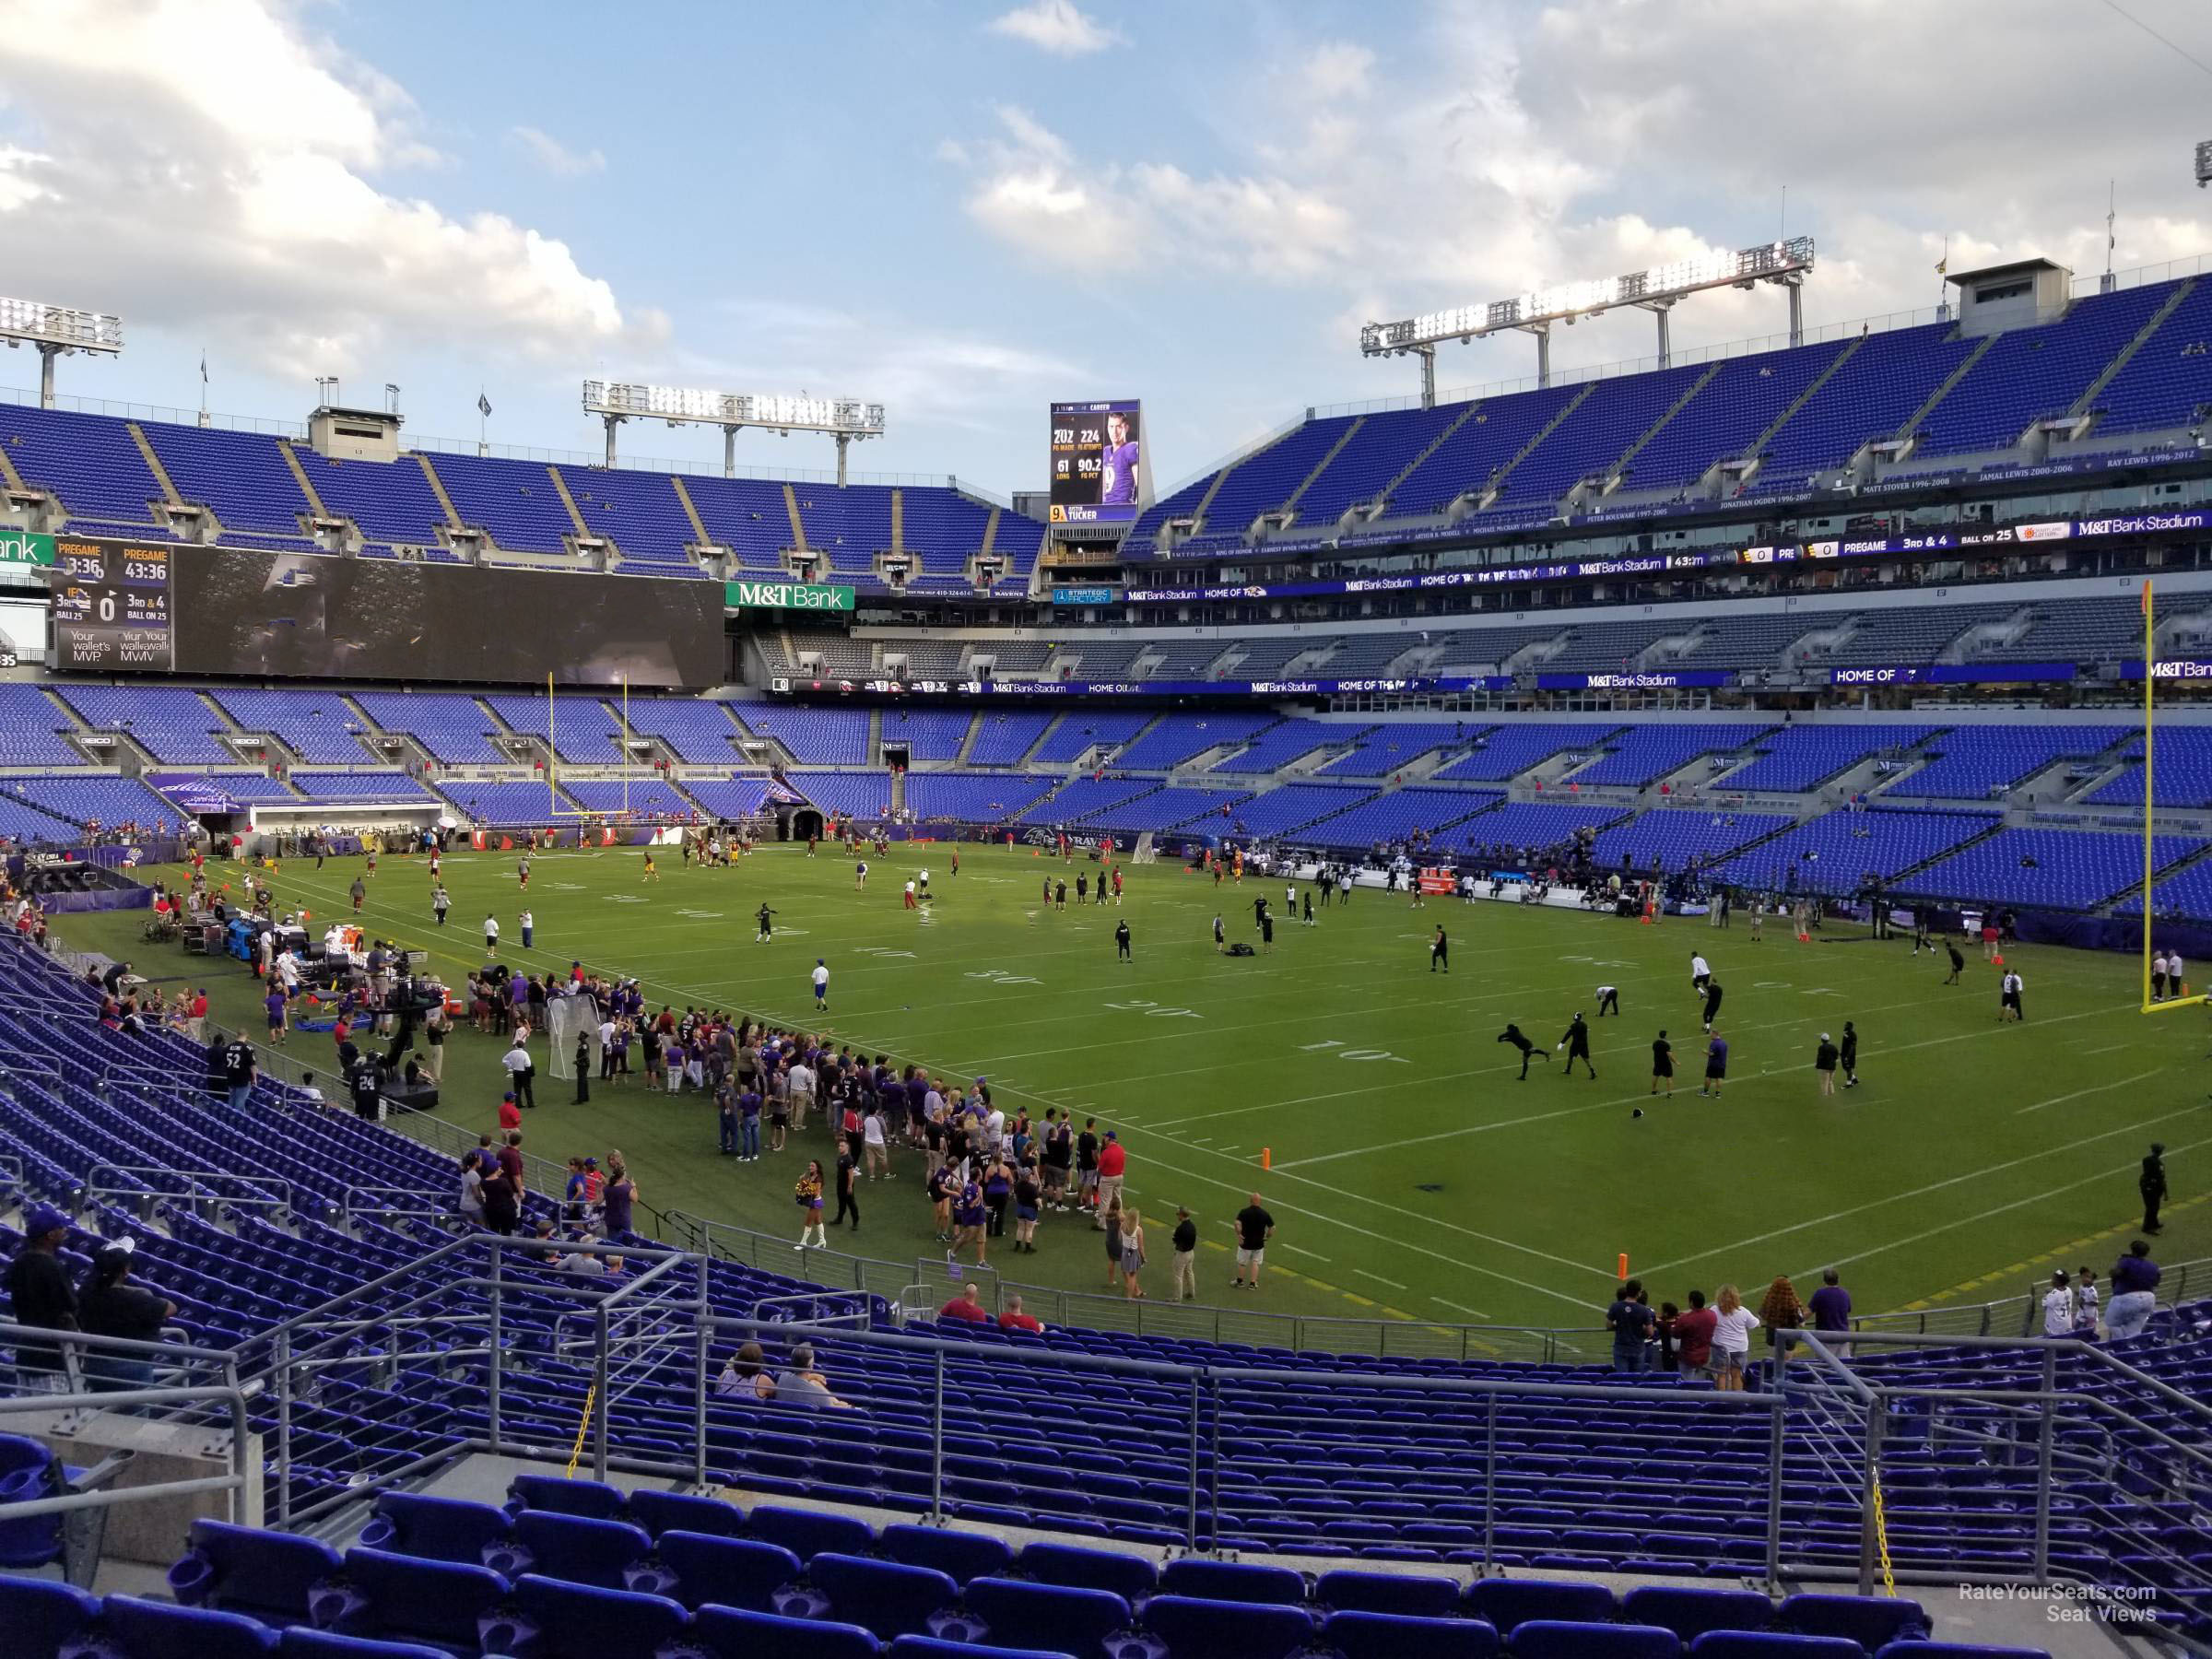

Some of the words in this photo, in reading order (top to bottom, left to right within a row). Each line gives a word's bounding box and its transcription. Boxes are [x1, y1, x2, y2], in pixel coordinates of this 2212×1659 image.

[1080, 430, 1100, 442] 224
[2107, 459, 2123, 467] RAY
[2124, 456, 2148, 465] LEWIS
[2150, 450, 2194, 463] 1996-2012
[1057, 459, 1069, 472] 61
[1078, 459, 1101, 471] 90.2
[1979, 471, 2004, 482] JAMAL
[2005, 469, 2029, 478] LEWIS
[2030, 465, 2073, 477] 2000-2006
[1863, 485, 1881, 494] MATT
[1883, 483, 1910, 491] STOVER
[1720, 499, 1752, 509] JONATHAN
[1754, 496, 1776, 504] OGDEN
[1778, 493, 1812, 502] 1996-2007
[1053, 508, 1060, 519] 9
[1068, 511, 1097, 521] TUCKER
[1587, 514, 1605, 523] PETER
[1606, 512, 1635, 521] BOULWARE
[2078, 520, 2112, 535] M&T
[2112, 519, 2145, 533] Bank
[2146, 514, 2202, 531] Stadium
[1903, 538, 1923, 548] 3RD
[1925, 537, 1936, 547] &
[1938, 535, 1947, 547] 4
[1961, 535, 1980, 545] BALL
[1983, 534, 1994, 542] ON
[1996, 529, 2012, 541] 25
[58, 543, 100, 556] PREGAME
[1823, 545, 1831, 555] 0
[1844, 540, 1887, 553] PREGAME
[124, 548, 168, 562] PREGAME
[1758, 550, 1766, 559] 0
[125, 562, 166, 580] 43:36
[1579, 564, 1602, 575] M&T
[1602, 561, 1623, 572] Bank
[1624, 559, 1660, 571] Stadium
[1346, 582, 1364, 592] M&T
[1364, 580, 1381, 590] Bank
[1382, 579, 1411, 589] Stadium
[1421, 575, 1445, 585] HOME
[1448, 574, 1459, 584] OF
[738, 583, 792, 606] M&T
[794, 585, 842, 608] Bank
[1128, 591, 1147, 600] M&T
[1147, 591, 1165, 600] Bank
[1166, 590, 1196, 600] Stadium
[1205, 589, 1228, 598] HOME
[1230, 588, 1241, 597] OF
[127, 594, 145, 607] 3RD
[147, 599, 155, 608] &
[156, 595, 164, 608] 4
[100, 597, 115, 621] 0
[127, 610, 145, 619] BALL
[146, 612, 157, 620] ON
[157, 612, 167, 620] 25
[74, 612, 83, 620] 25
[71, 630, 95, 641] Your
[73, 641, 111, 652] wallet's
[1587, 676, 1611, 687] M&T
[1612, 676, 1635, 687] Bank
[1636, 675, 1676, 687] Stadium
[1837, 670, 1874, 682] HOME
[1877, 670, 1895, 681] OF
[993, 684, 1013, 692] M&T
[1014, 684, 1032, 692] Bank
[1033, 684, 1065, 692] Stadium
[1089, 684, 1113, 692] HOME
[1252, 682, 1269, 692] M&T
[1270, 683, 1287, 691] Bank
[1288, 682, 1316, 691] Stadium
[1338, 681, 1362, 690] HOME
[1364, 681, 1376, 690] OF
[1074, 836, 1123, 848] RAVS
[1298, 1040, 1392, 1060] 10
[227, 1053, 241, 1069] 52
[359, 1076, 375, 1090] 24
